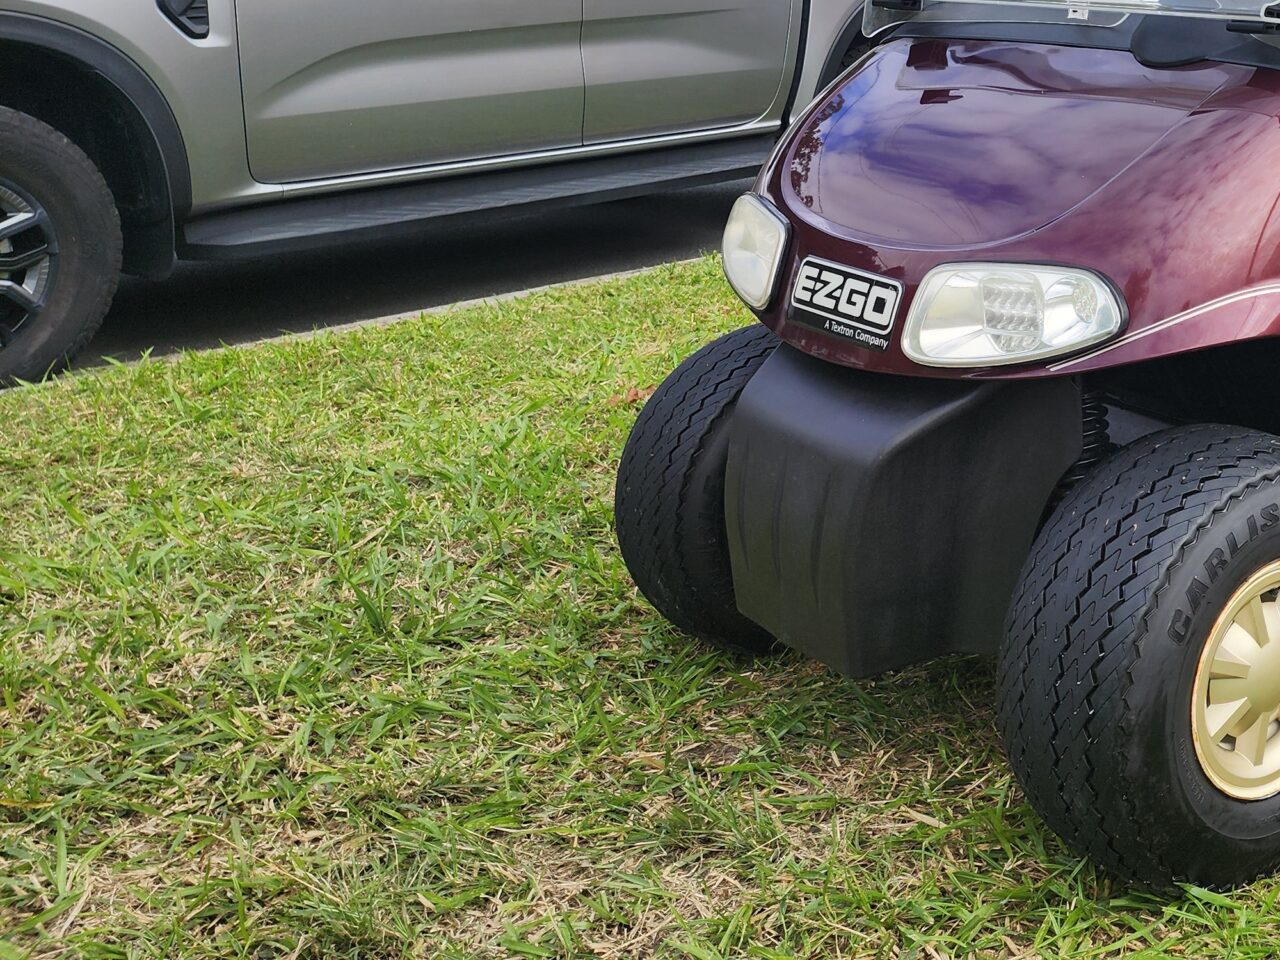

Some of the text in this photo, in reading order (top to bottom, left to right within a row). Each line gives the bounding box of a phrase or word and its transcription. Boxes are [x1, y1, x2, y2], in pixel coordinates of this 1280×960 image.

[824, 320, 888, 350] A Textron Company
